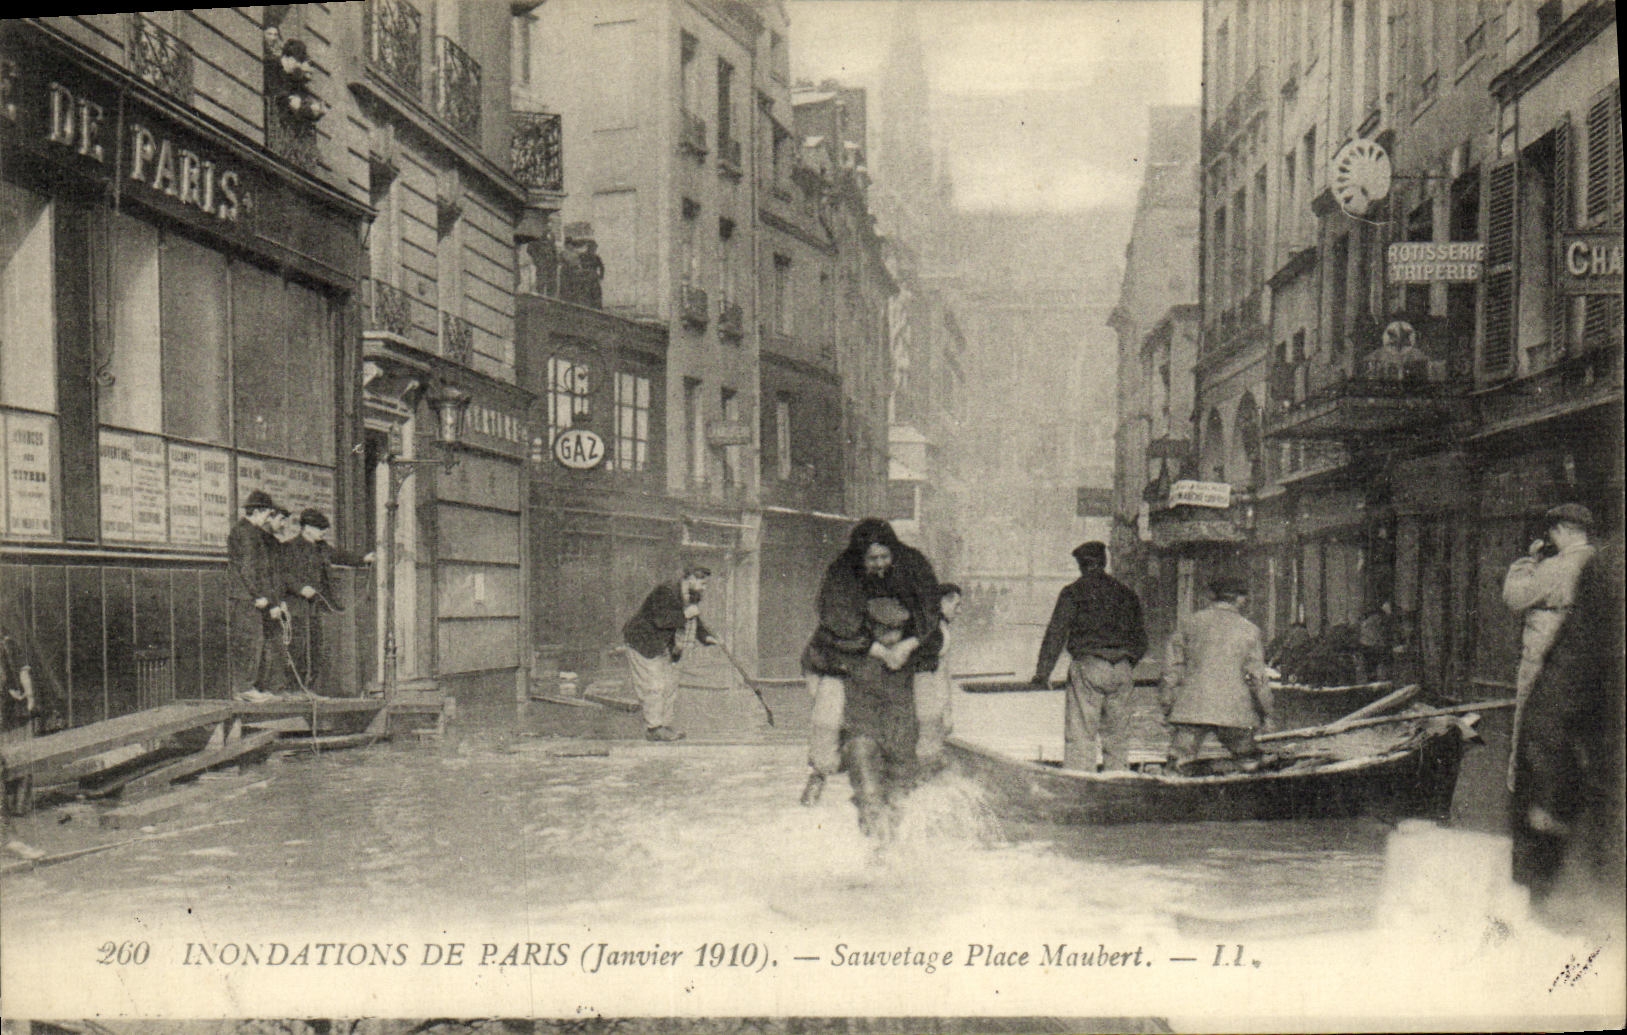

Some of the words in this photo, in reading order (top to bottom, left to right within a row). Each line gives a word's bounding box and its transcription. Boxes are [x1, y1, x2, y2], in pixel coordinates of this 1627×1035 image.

[48, 82, 103, 163] DE
[130, 123, 240, 220] PARIS
[1392, 262, 1479, 281] TRIPERIE
[560, 434, 600, 463] GAZ
